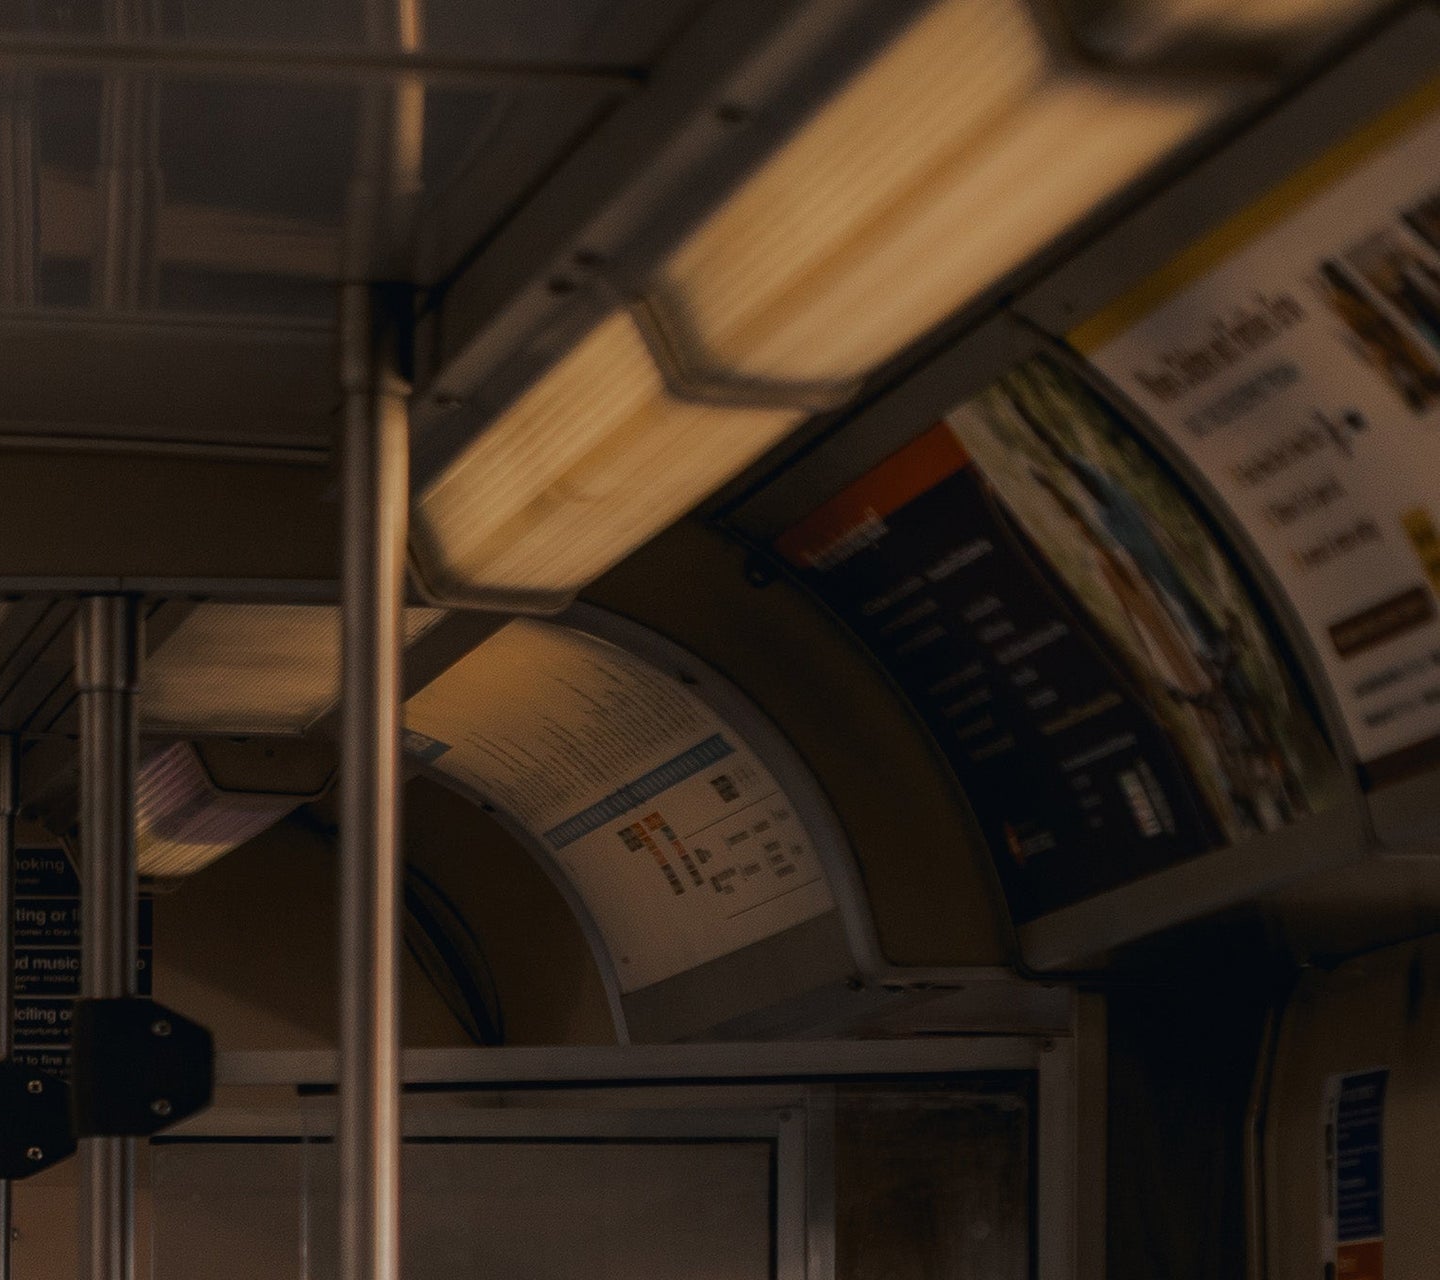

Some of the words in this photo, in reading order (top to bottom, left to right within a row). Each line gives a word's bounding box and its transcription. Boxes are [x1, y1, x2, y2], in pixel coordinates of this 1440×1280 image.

[15, 859, 65, 874] oking
[15, 908, 47, 926] ting
[32, 955, 80, 970] music
[27, 1055, 38, 1065] to
